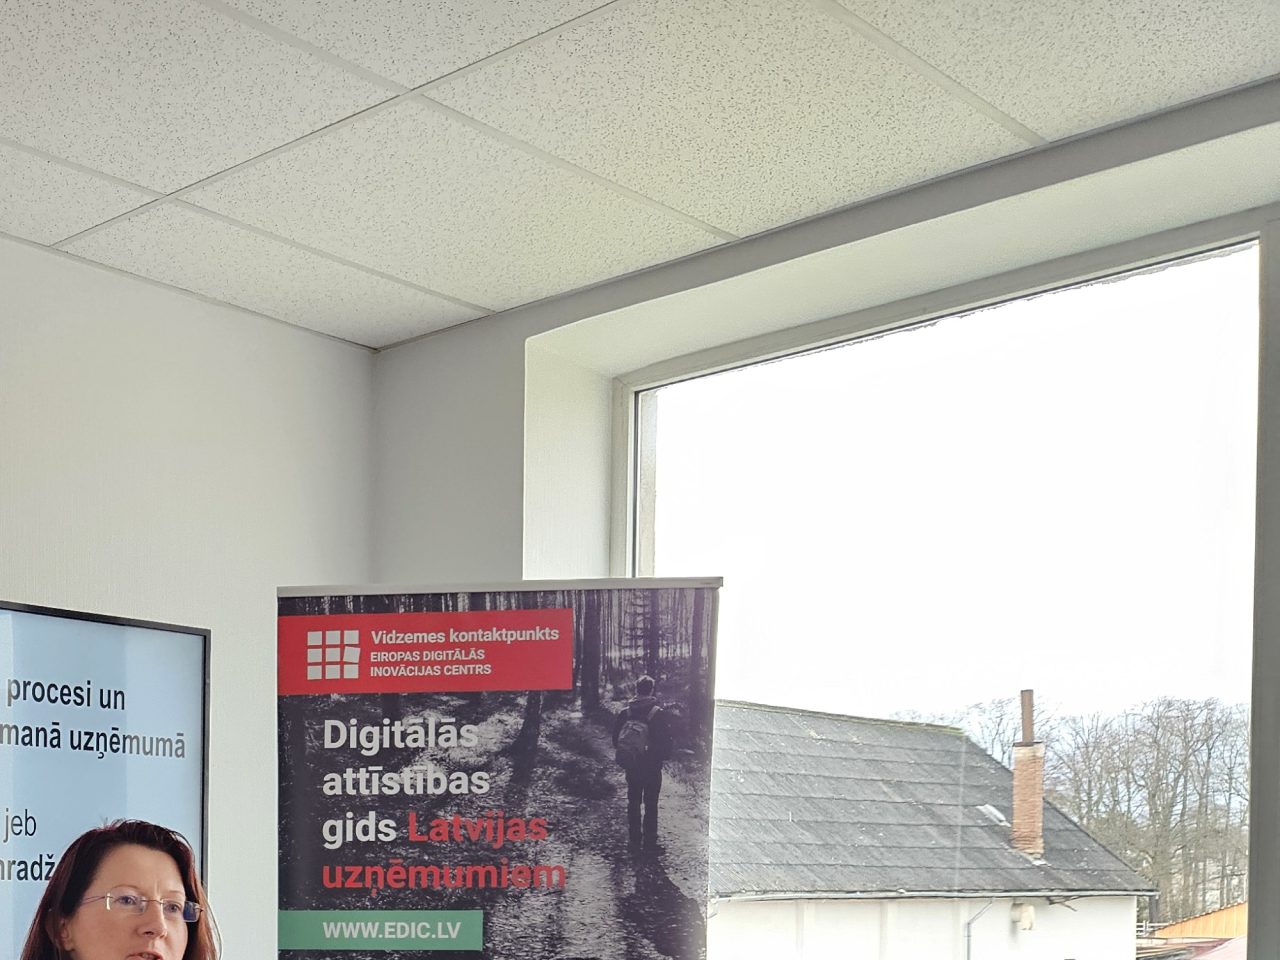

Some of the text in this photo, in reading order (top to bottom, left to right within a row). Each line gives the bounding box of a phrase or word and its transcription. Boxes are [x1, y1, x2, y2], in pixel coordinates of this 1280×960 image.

[371, 626, 560, 645] Vidzemes kontaktpunkts
[370, 648, 485, 662] EIROPAS DIGITĀLĀS
[370, 664, 492, 677] INOVĀCIJAS CENTRS
[7, 680, 92, 708] procesi
[99, 687, 125, 710] un
[0, 721, 61, 749] manā
[70, 727, 186, 759] uzņēmumā
[323, 717, 479, 756] Digitālās
[322, 765, 490, 797] attīstības
[3, 807, 37, 843] jeb
[322, 810, 549, 850] gids Latvijas
[322, 858, 566, 896] uzņēmumiem
[322, 920, 461, 940] WWW.EDIC.LV
